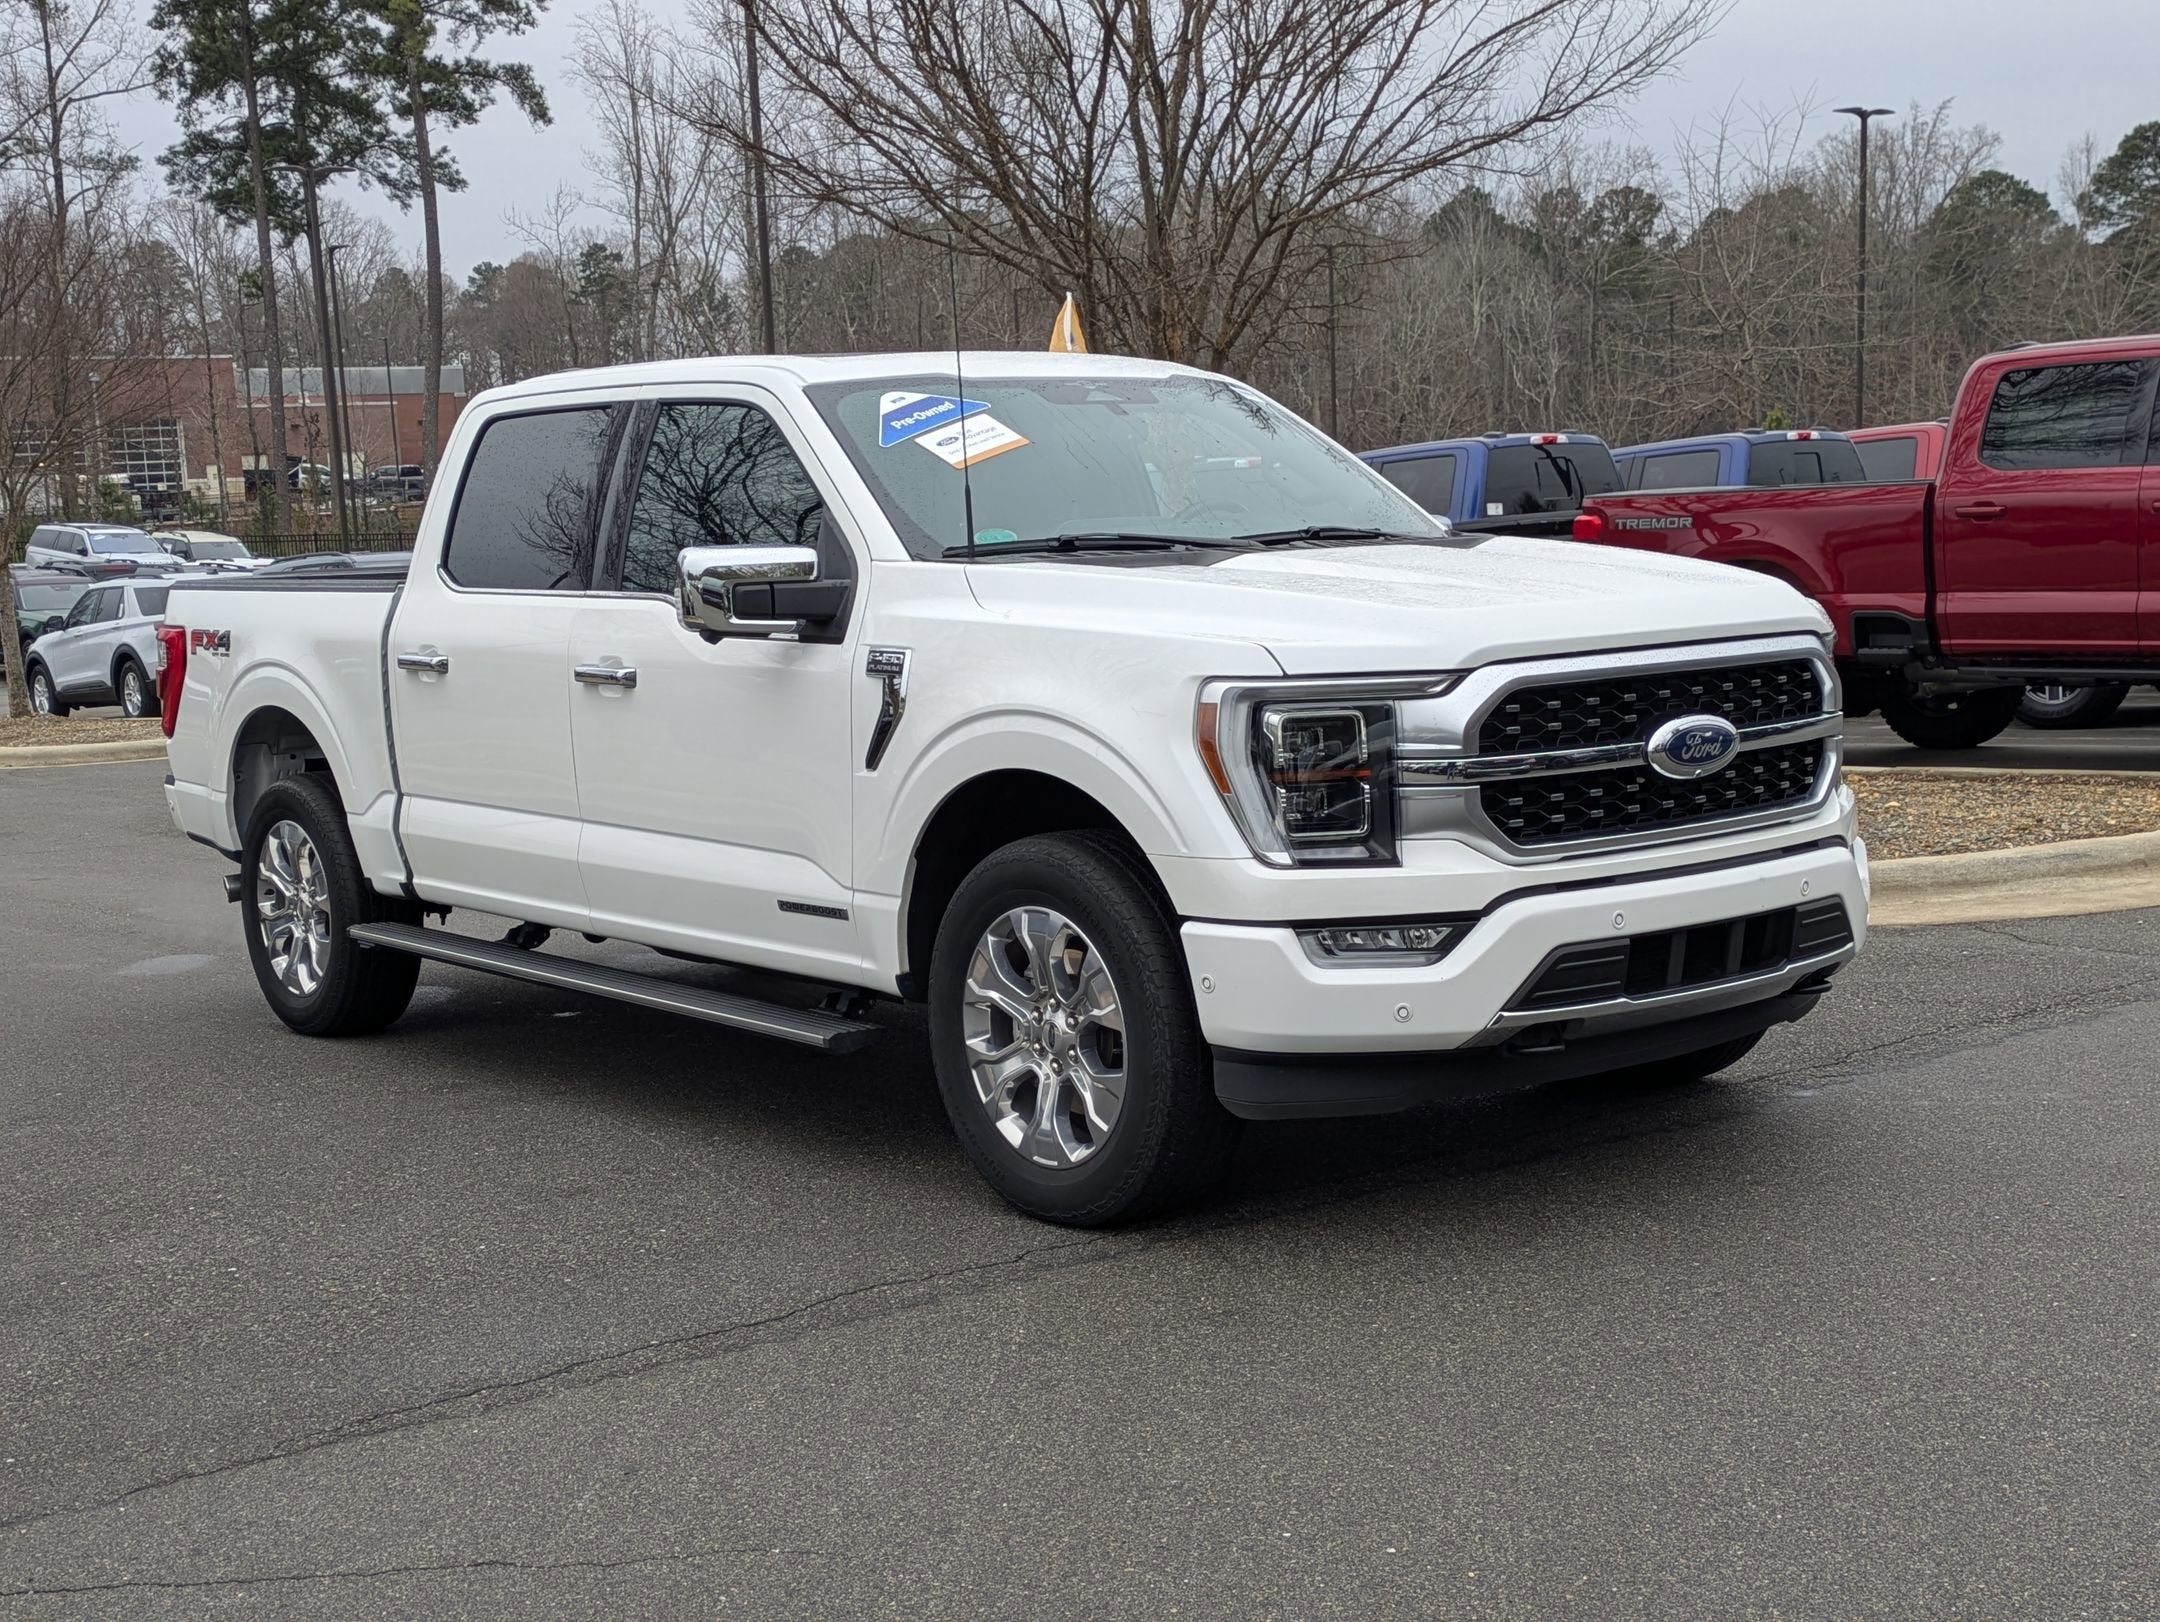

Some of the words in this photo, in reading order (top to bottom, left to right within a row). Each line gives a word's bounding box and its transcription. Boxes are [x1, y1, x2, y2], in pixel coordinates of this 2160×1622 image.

[890, 400, 956, 430] Pre-Owned
[1615, 517, 1693, 530] TREMOR
[191, 628, 231, 655] FX4
[1681, 731, 1723, 760] Ford
